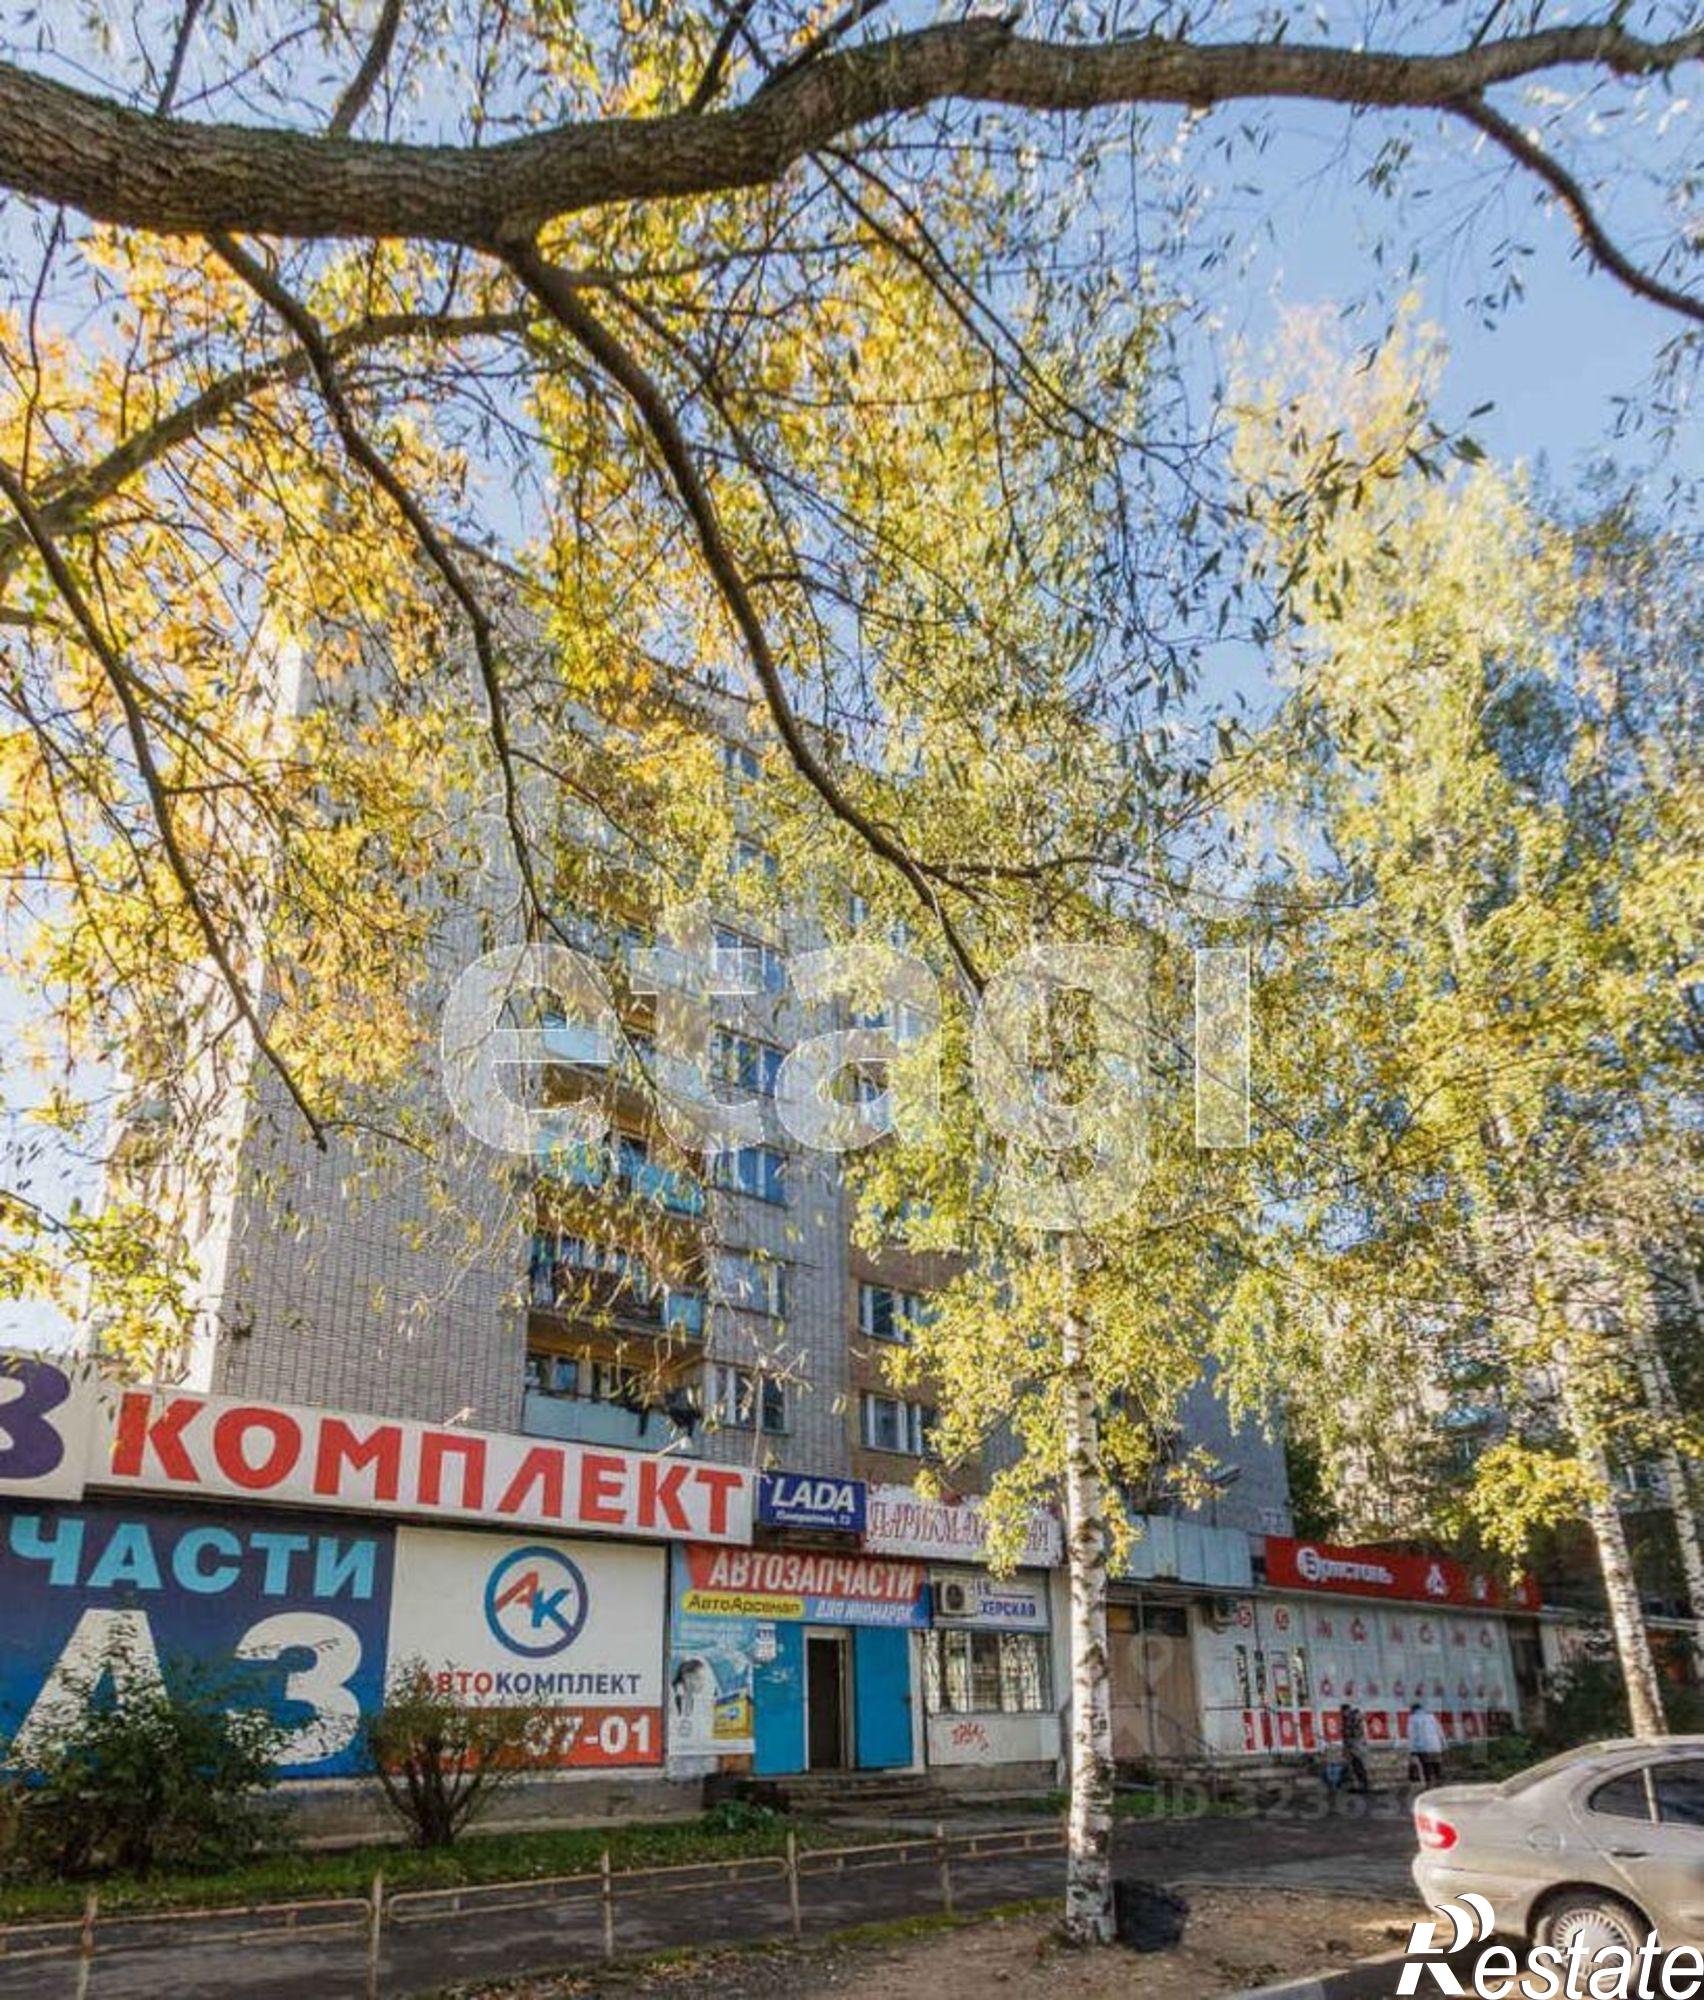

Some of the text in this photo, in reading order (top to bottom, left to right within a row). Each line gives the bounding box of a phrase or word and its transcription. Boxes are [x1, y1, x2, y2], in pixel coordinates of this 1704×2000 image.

[111, 1391, 743, 1536] КОМПЛЕКТ
[772, 1478, 856, 1513] LADA
[9, 1515, 377, 1599] ЧАСТИ
[708, 1551, 917, 1599] АВТОЗАПЧАСТИ
